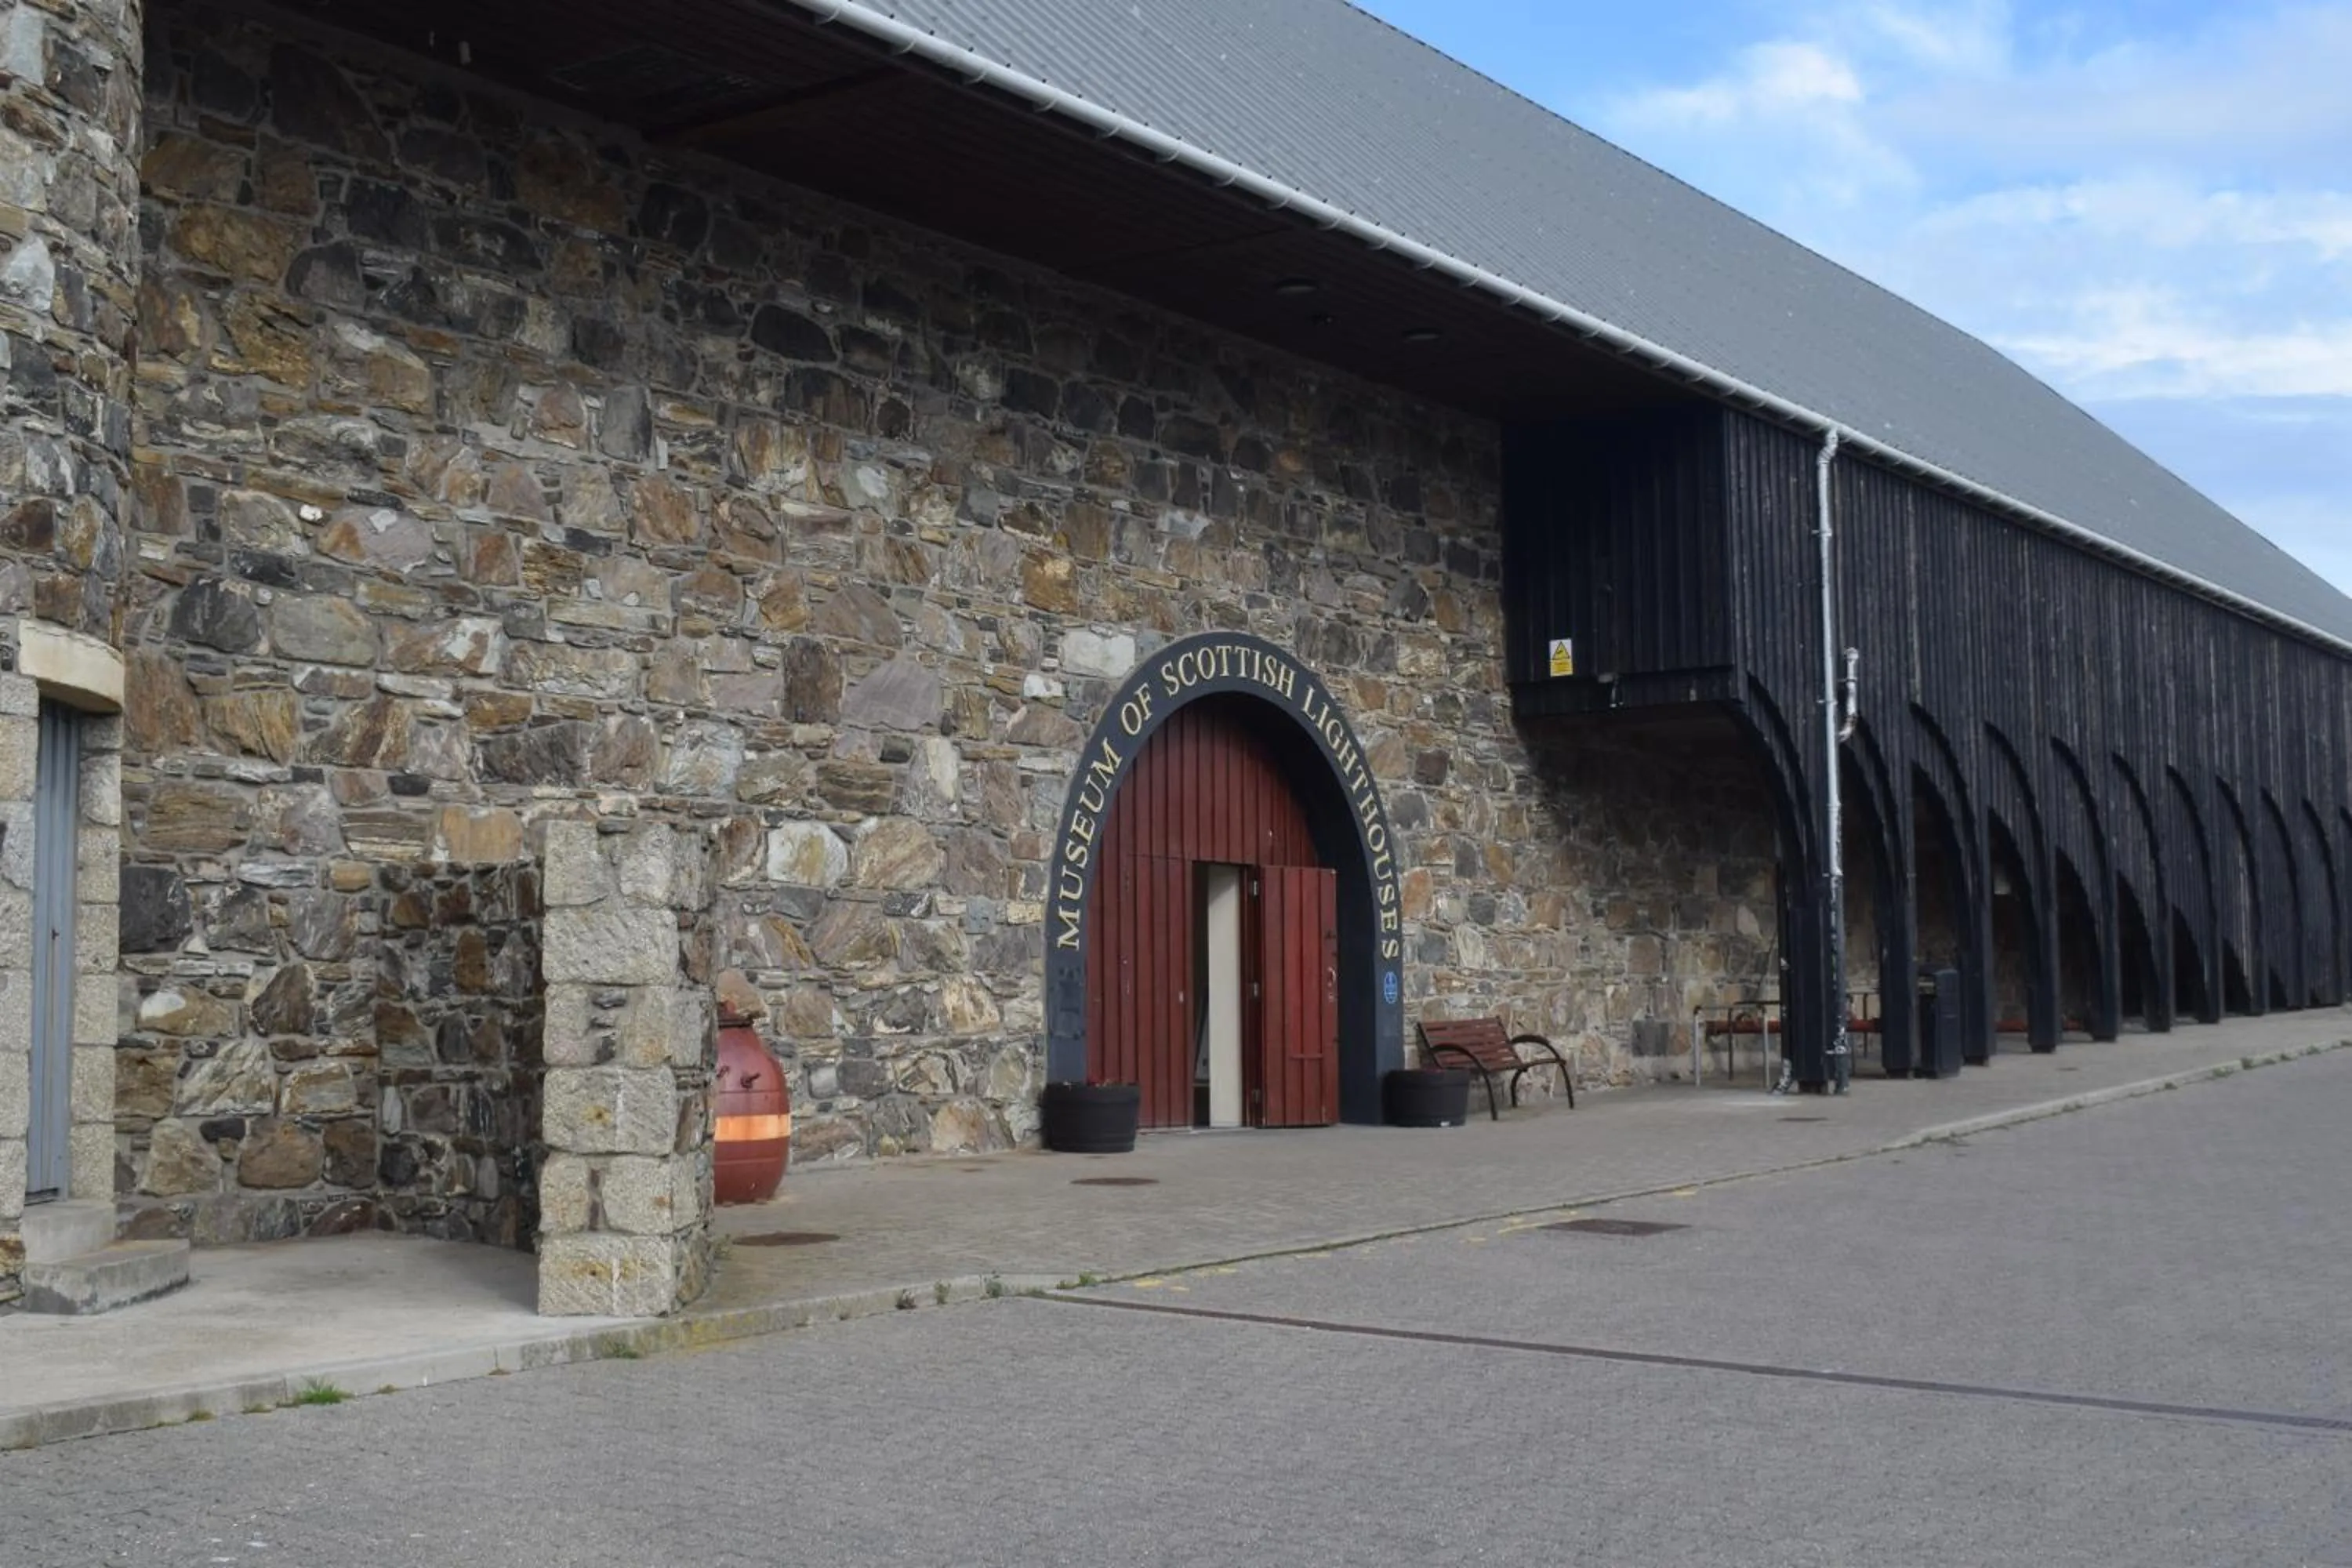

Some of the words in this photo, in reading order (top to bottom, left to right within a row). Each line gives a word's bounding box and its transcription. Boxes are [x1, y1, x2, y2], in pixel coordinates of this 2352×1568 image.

[1057, 736, 1123, 951] MUSEUM
[1120, 683, 1153, 737] OF
[1161, 644, 1298, 700] SCOTTISH
[1301, 684, 1400, 960] LIGHTHOUSES
